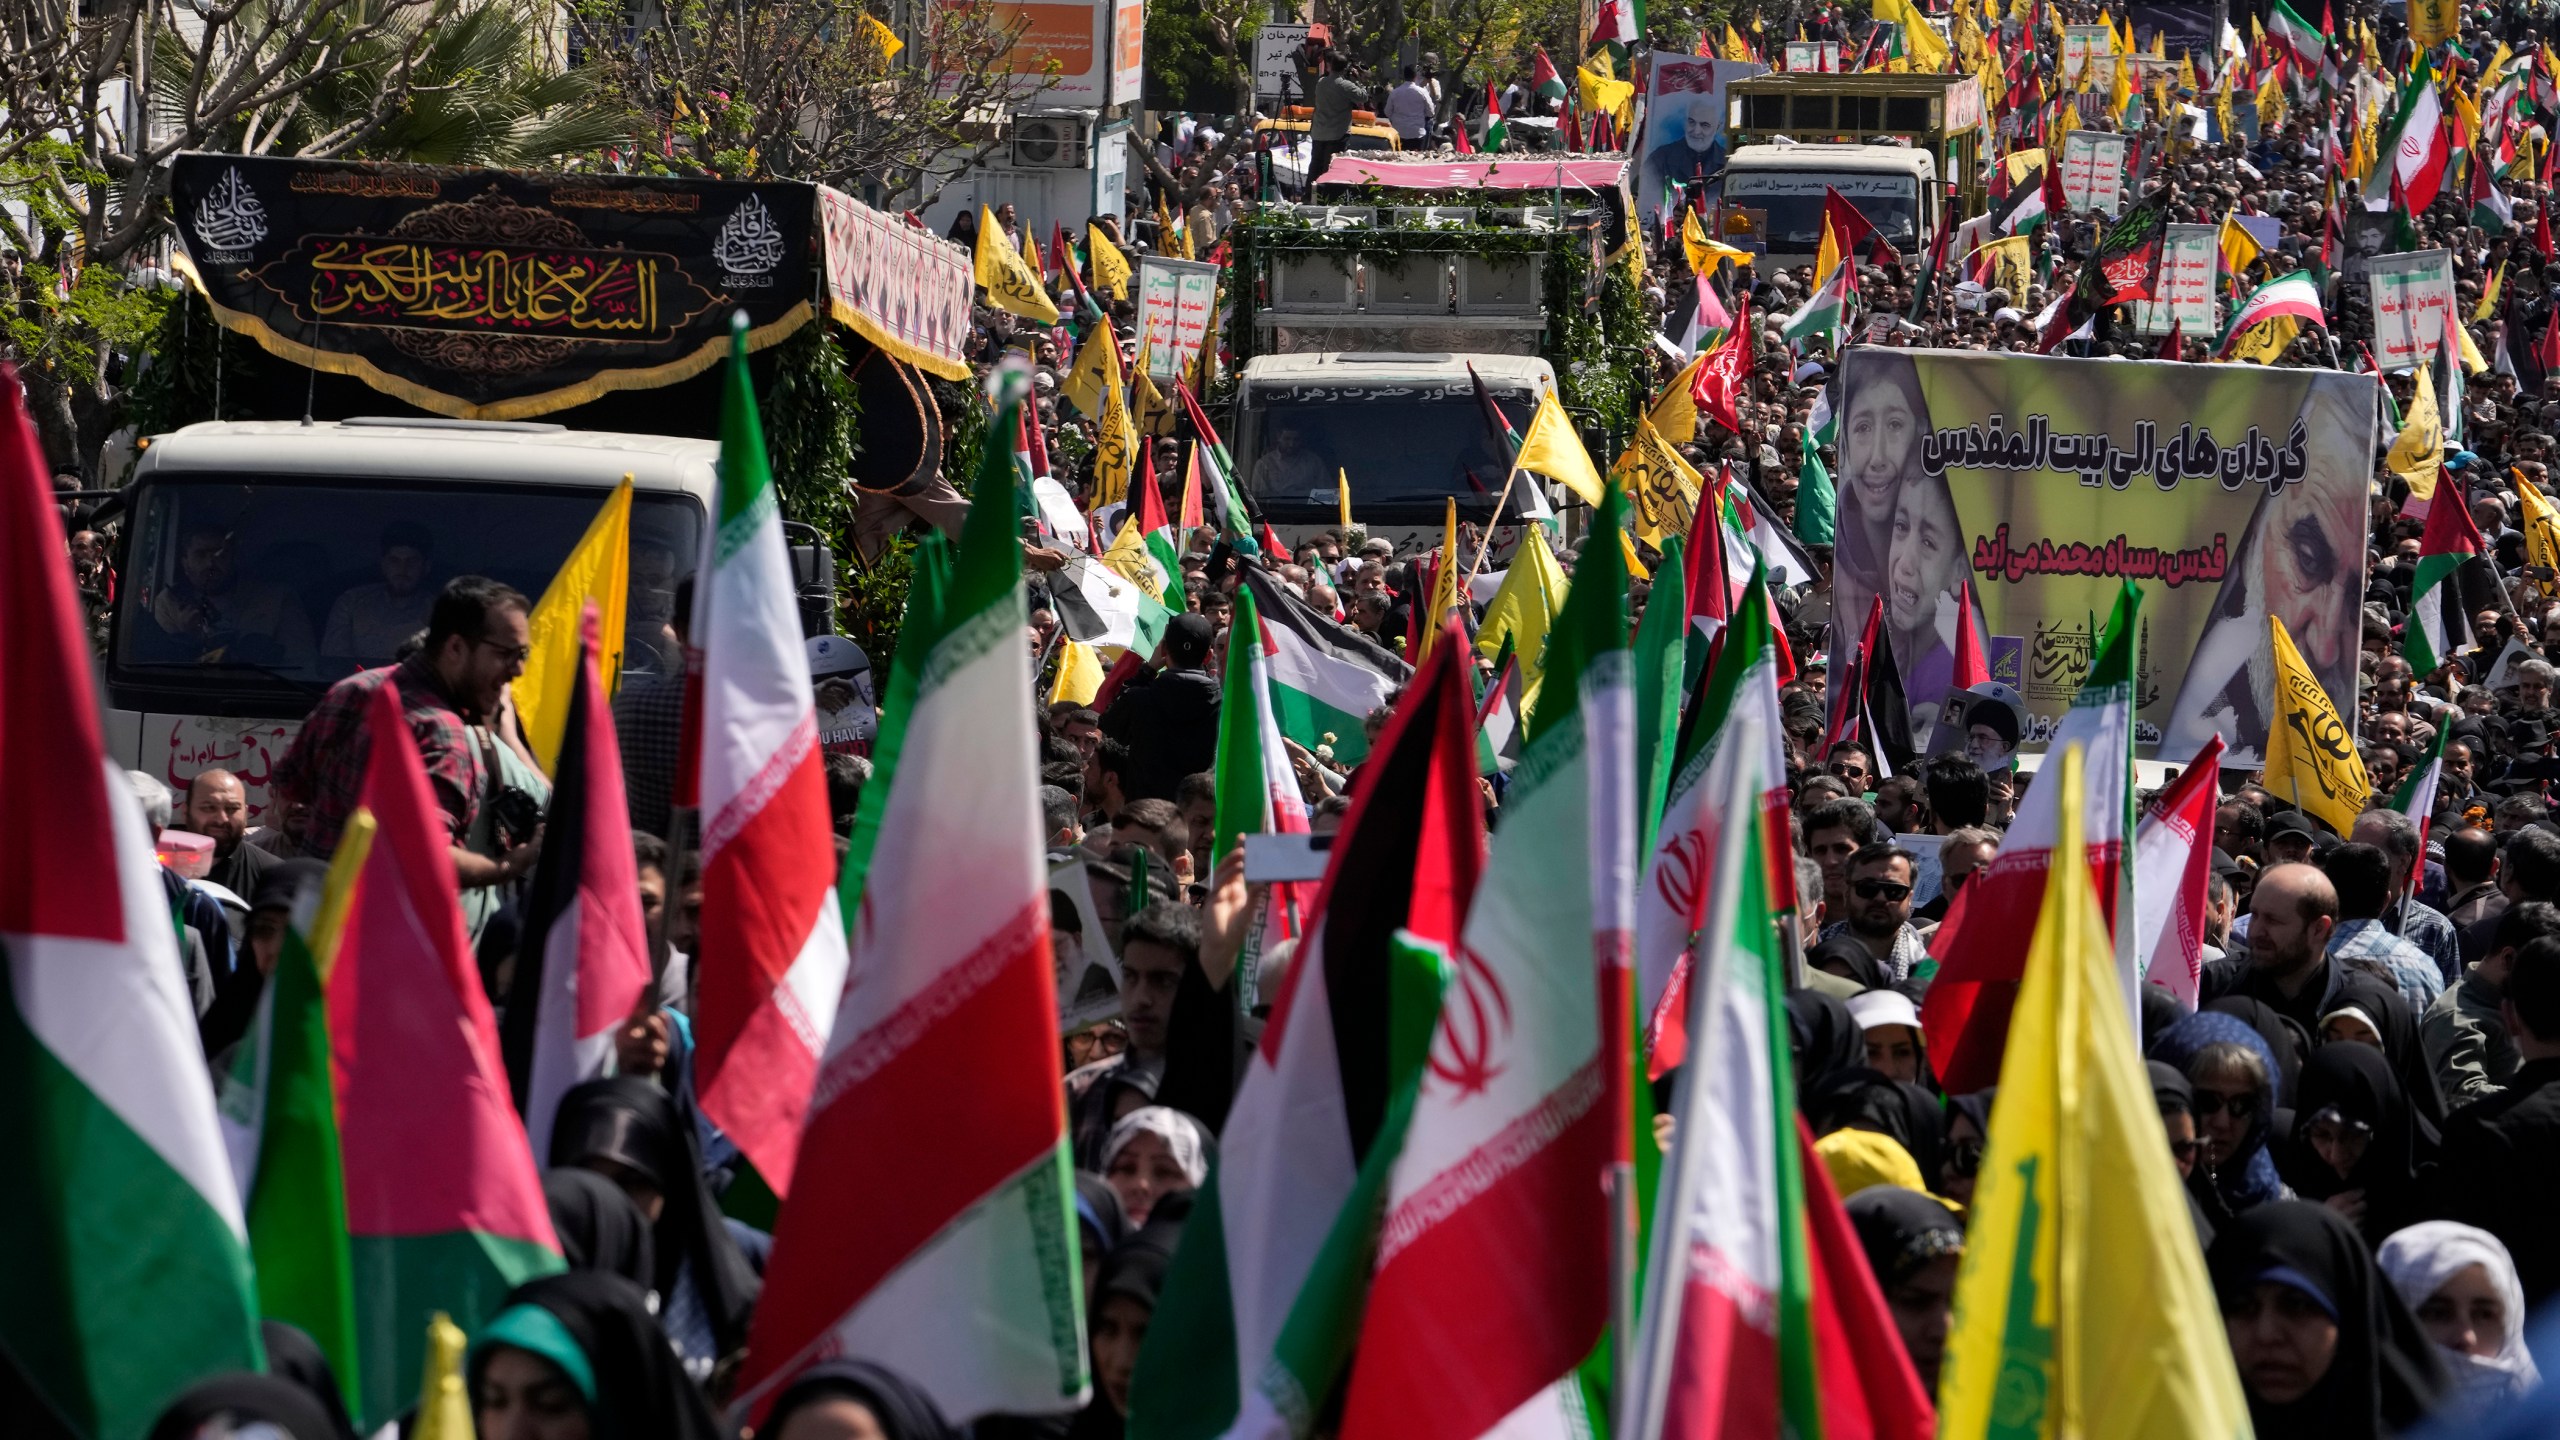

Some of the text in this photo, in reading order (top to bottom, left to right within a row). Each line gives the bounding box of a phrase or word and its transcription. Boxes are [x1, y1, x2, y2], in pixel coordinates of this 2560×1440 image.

[1267, 30, 1286, 40] خان
[1769, 181, 1799, 192] رسول
[1801, 182, 1823, 191] محمد
[1291, 384, 1339, 401] زهرا
[1343, 384, 1415, 401] حضرت
[1920, 414, 2049, 475] المقدس
[2047, 431, 2109, 487] بیت
[2107, 419, 2157, 491] الی
[2217, 417, 2308, 495] گردان
[2039, 540, 2108, 579] محمد
[832, 726, 864, 743] HAVE
